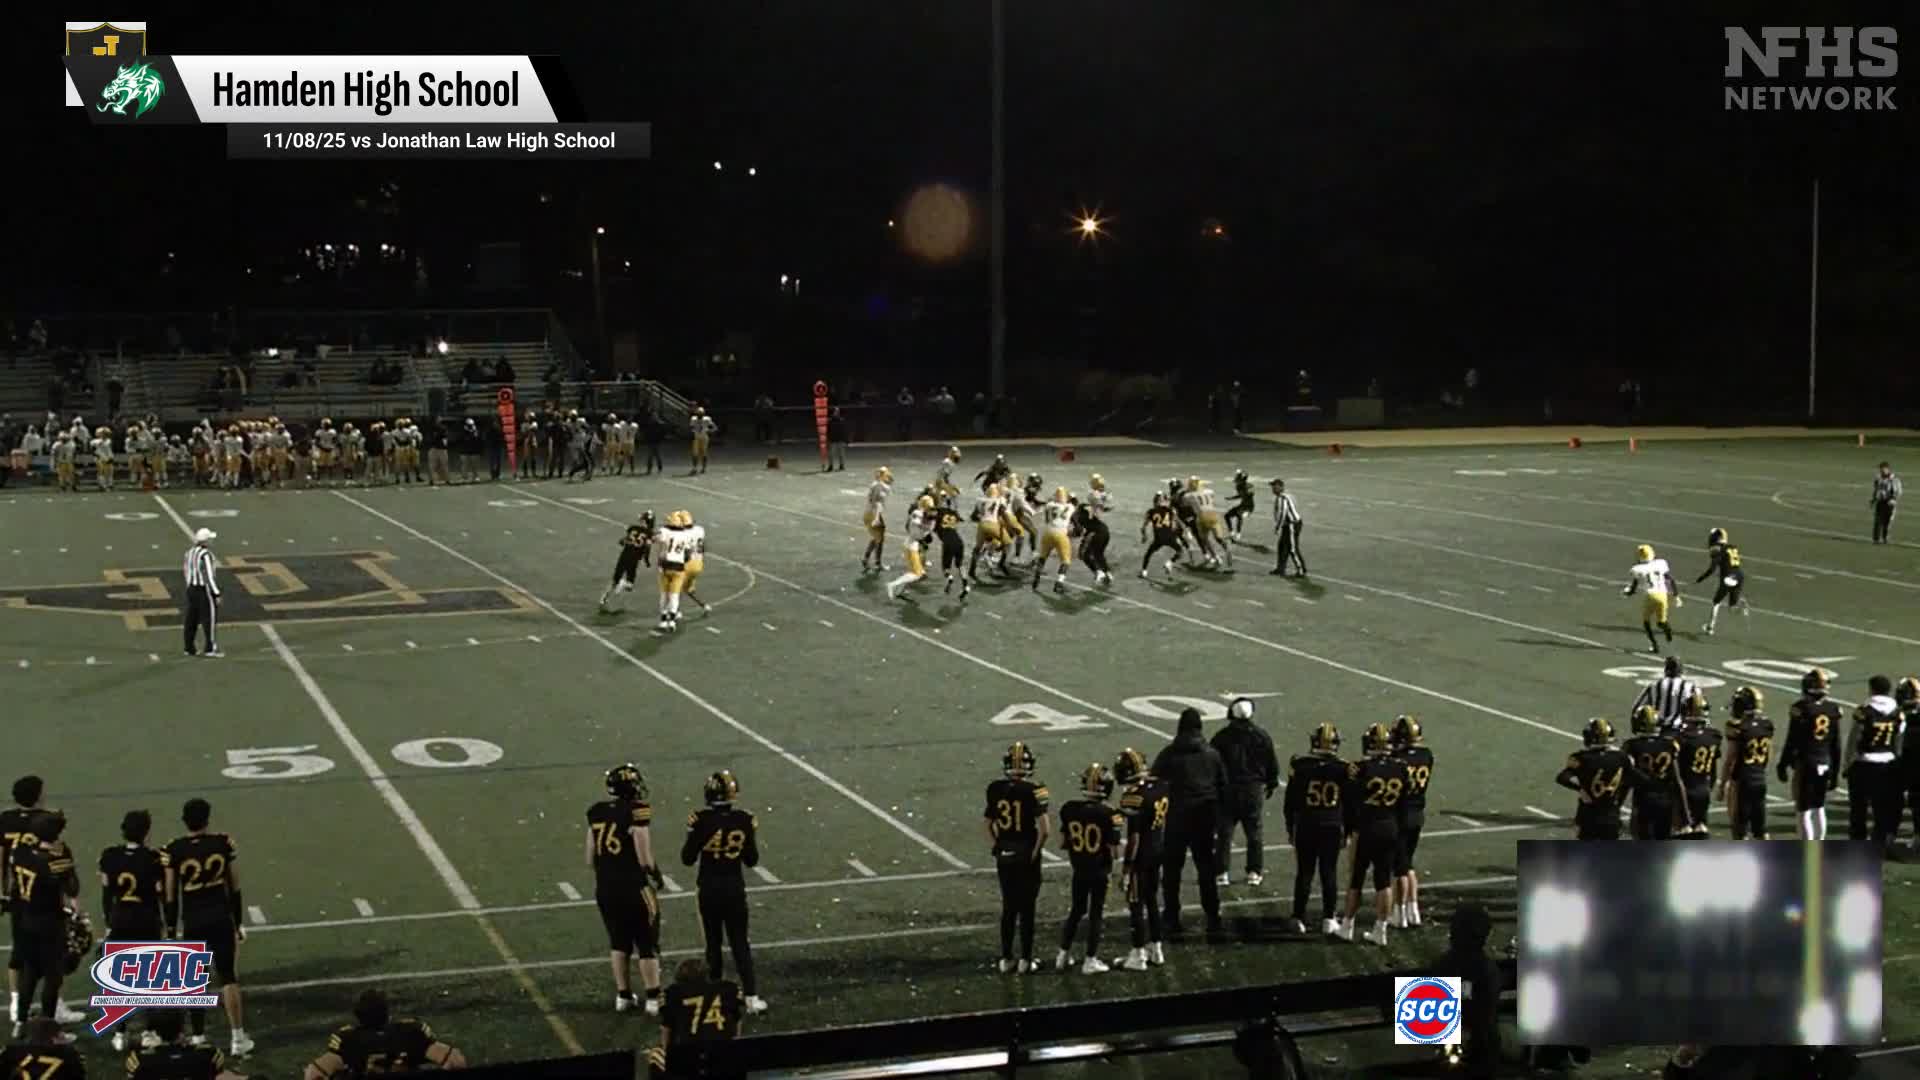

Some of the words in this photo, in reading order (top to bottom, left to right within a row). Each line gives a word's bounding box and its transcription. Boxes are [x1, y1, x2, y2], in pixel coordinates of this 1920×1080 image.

[1152, 513, 1170, 527] 24
[1815, 714, 1830, 740] 8
[1306, 780, 1339, 807] 50
[1366, 777, 1403, 806] 28
[1591, 767, 1623, 798] 64
[998, 800, 1022, 832] 31
[592, 823, 621, 856] 76
[703, 829, 745, 859] 48
[15, 865, 36, 901] 17
[117, 872, 141, 902] 2
[180, 854, 225, 891] 22
[682, 996, 726, 1034] 74
